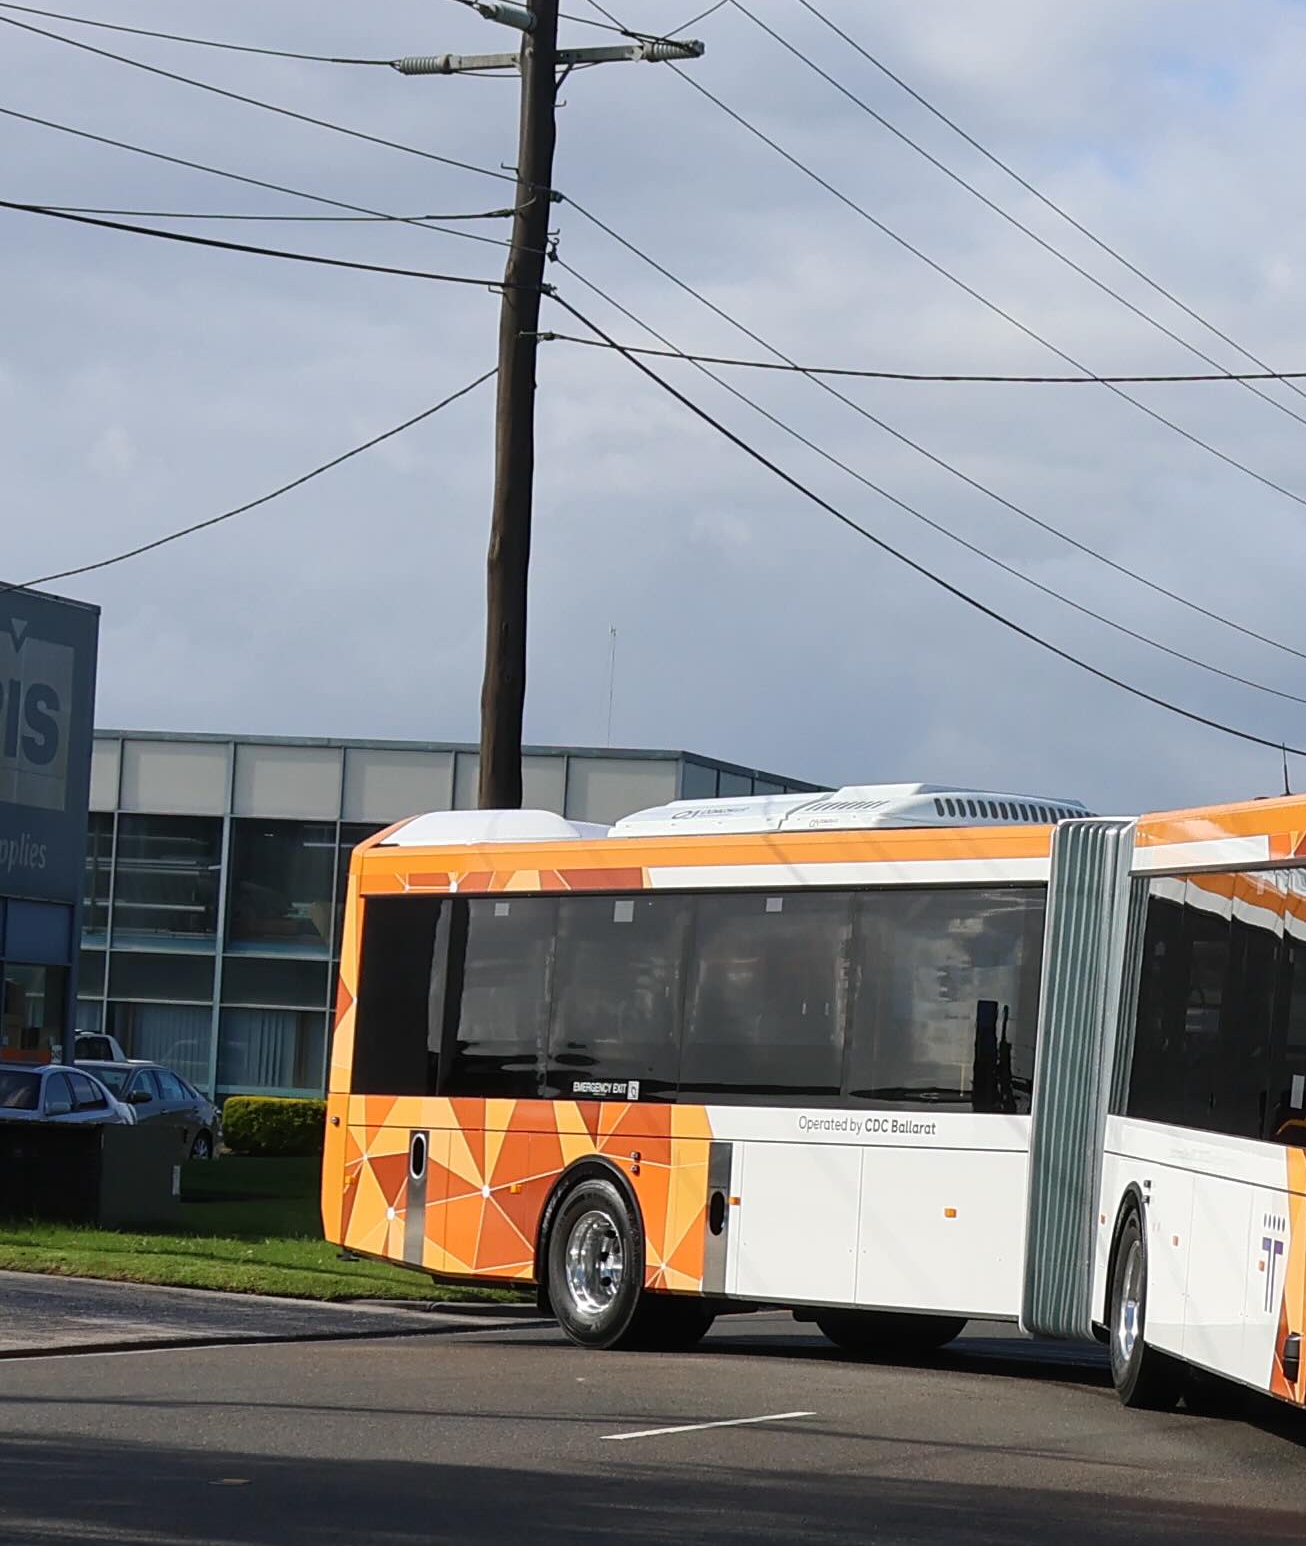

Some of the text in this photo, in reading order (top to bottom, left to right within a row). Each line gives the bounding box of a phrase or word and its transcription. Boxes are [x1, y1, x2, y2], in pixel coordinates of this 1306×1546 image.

[0, 678, 61, 766] IS
[798, 1115, 936, 1136] Operated by CDC Ballarat
